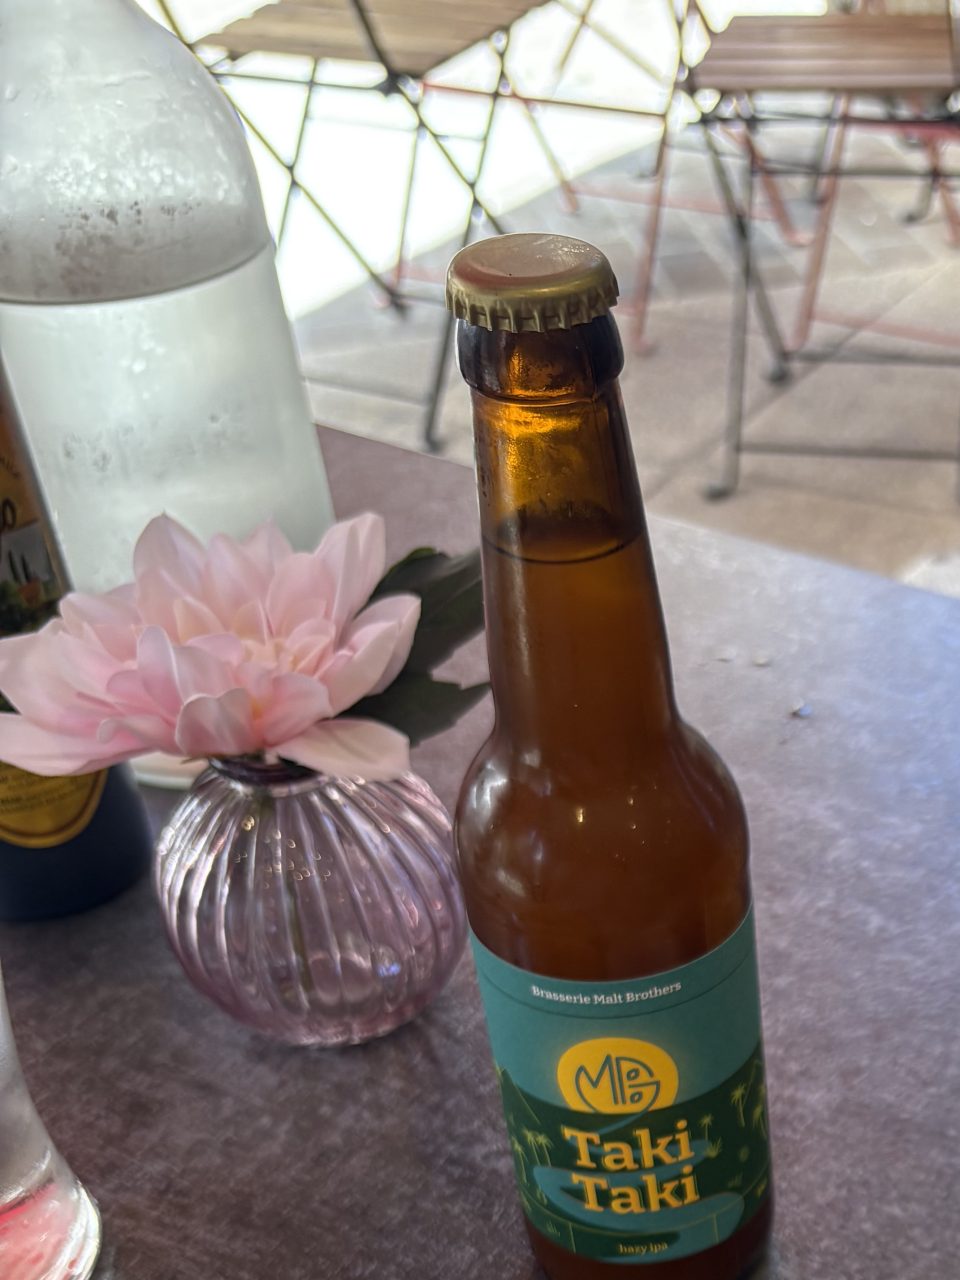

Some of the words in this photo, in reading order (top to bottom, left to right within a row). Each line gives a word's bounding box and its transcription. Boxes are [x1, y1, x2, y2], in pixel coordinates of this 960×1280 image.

[531, 984, 591, 1004] Brasserie
[593, 992, 624, 1005] Malt
[625, 982, 682, 1003] Brothers
[563, 1119, 695, 1171] Taki
[571, 1164, 700, 1215] Taki
